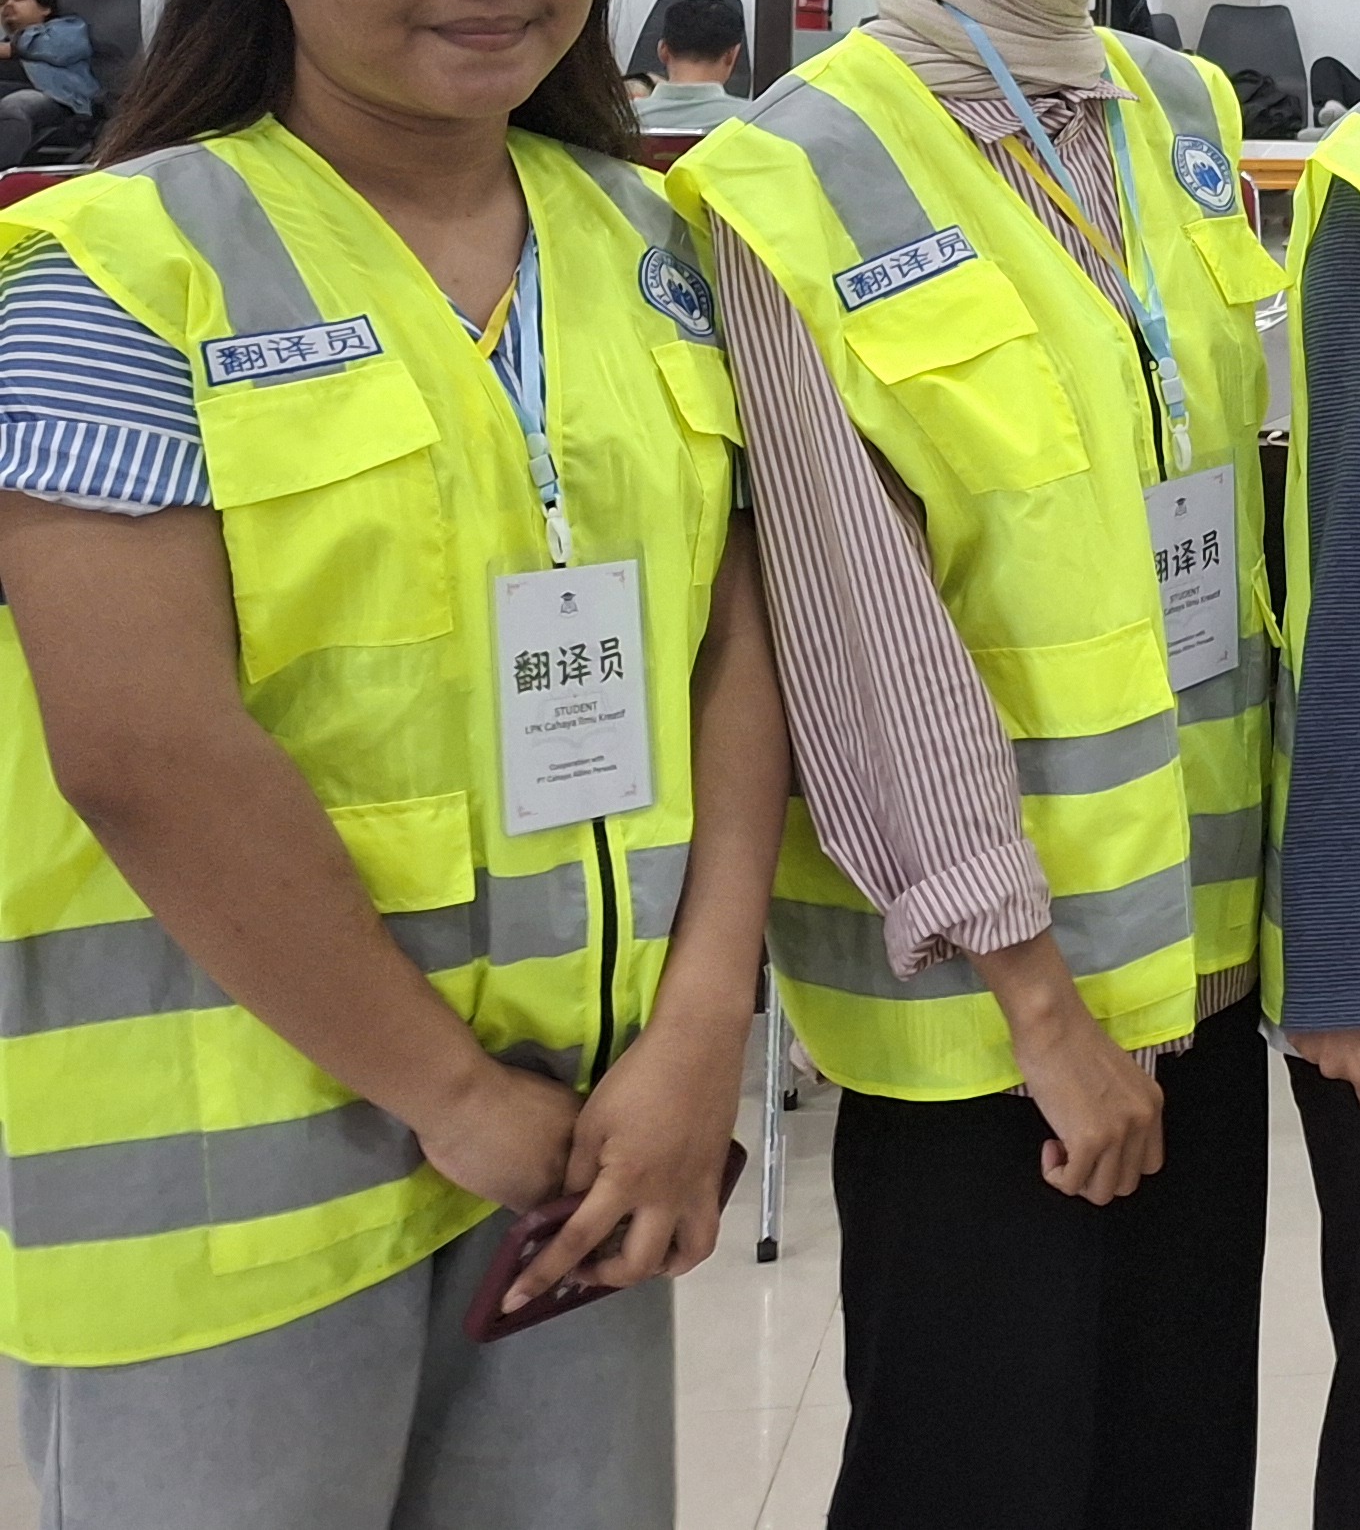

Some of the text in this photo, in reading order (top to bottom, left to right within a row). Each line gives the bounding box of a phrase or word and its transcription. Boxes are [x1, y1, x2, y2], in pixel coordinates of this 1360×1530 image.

[847, 232, 971, 299] 翻译员
[216, 326, 371, 376] 翻译员
[513, 636, 624, 694] 翻译员
[525, 724, 543, 734] LPK
[555, 701, 598, 717] STUDENT
